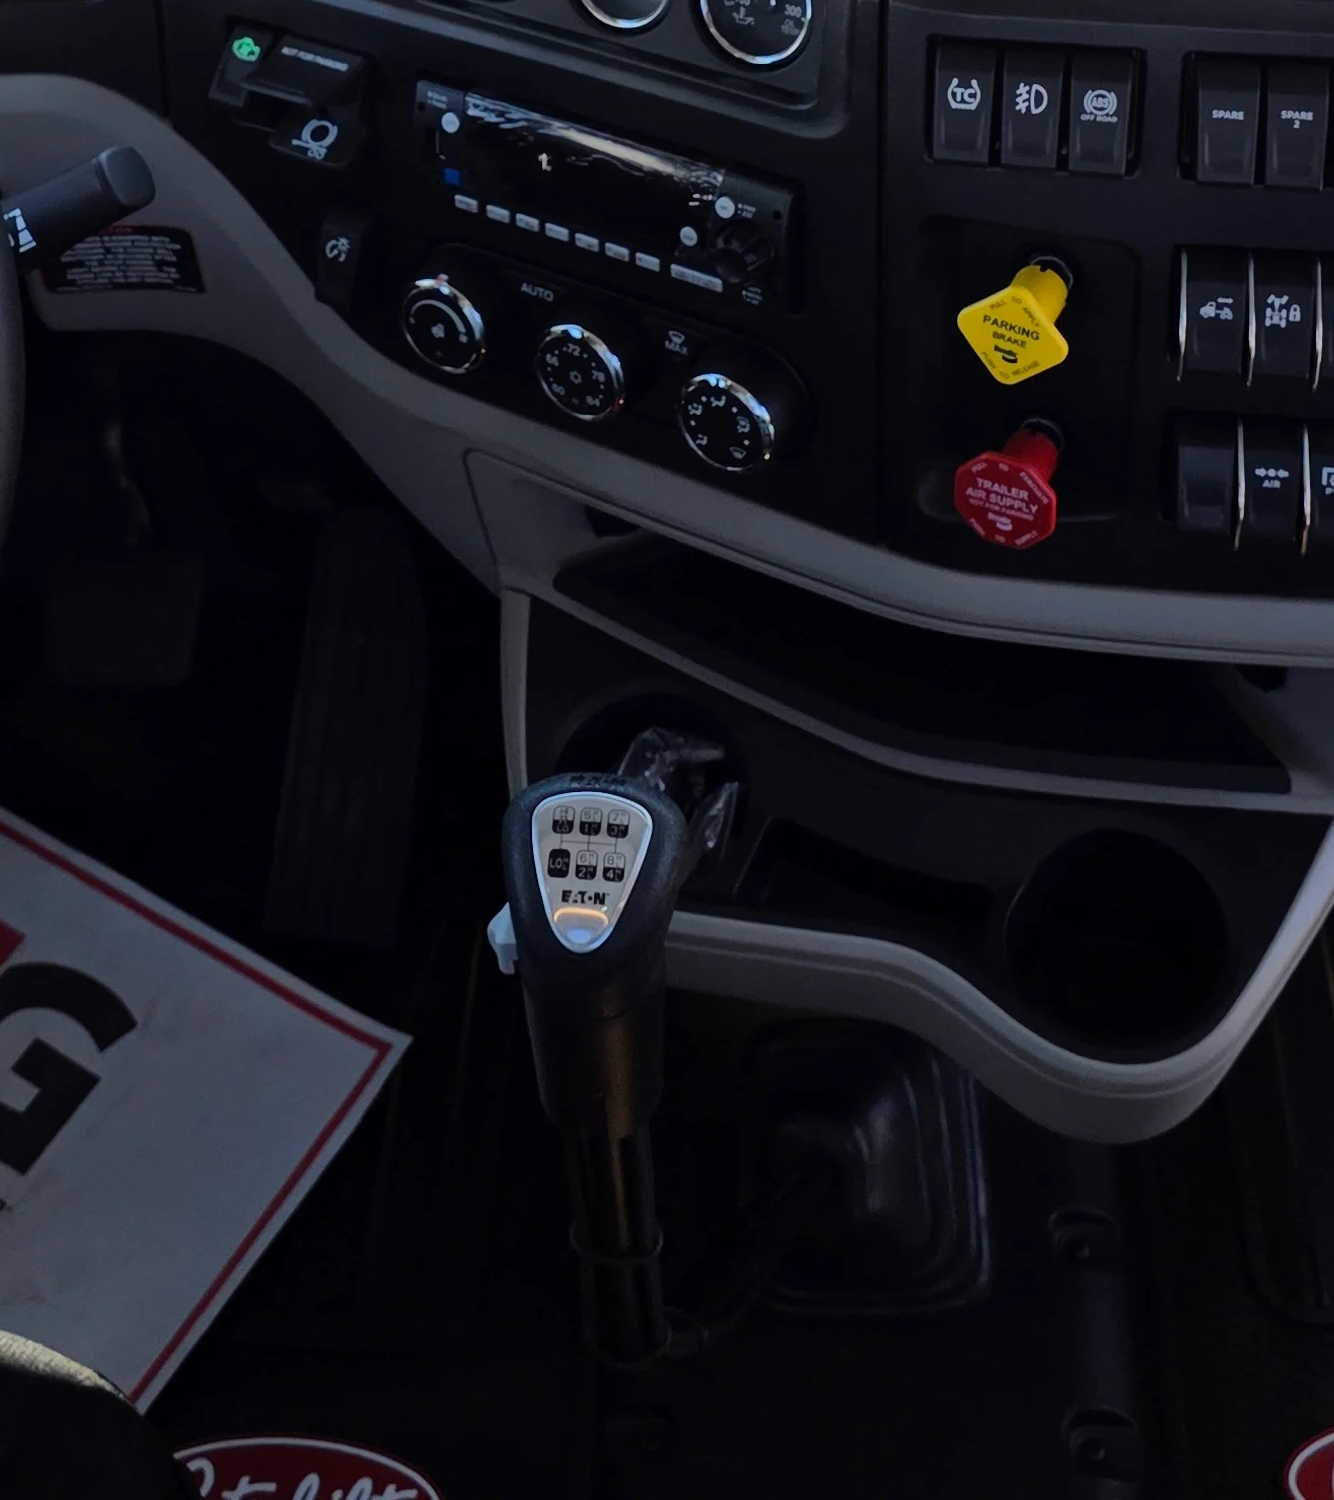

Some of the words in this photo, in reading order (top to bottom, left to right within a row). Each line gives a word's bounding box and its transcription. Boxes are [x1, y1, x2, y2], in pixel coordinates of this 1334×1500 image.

[784, 3, 802, 18] 300
[953, 86, 977, 103] TC
[1091, 96, 1110, 109] ABS
[1212, 109, 1244, 120] SPARE
[1281, 109, 1314, 121] SPARE
[1293, 119, 1300, 129] 2
[520, 282, 555, 303] AUTO
[983, 314, 1041, 342] PARKING
[992, 330, 1028, 350] BRAKE
[567, 342, 581, 357] 72
[976, 477, 1030, 501] TRAILER
[1262, 479, 1282, 490] AIR
[965, 486, 987, 501] AIR
[988, 492, 1039, 515] SUPPLY
[549, 857, 563, 869] LO
[607, 855, 615, 866] 8
[578, 866, 587, 878] 2
[606, 869, 615, 880] 4
[561, 888, 607, 907] EATON
